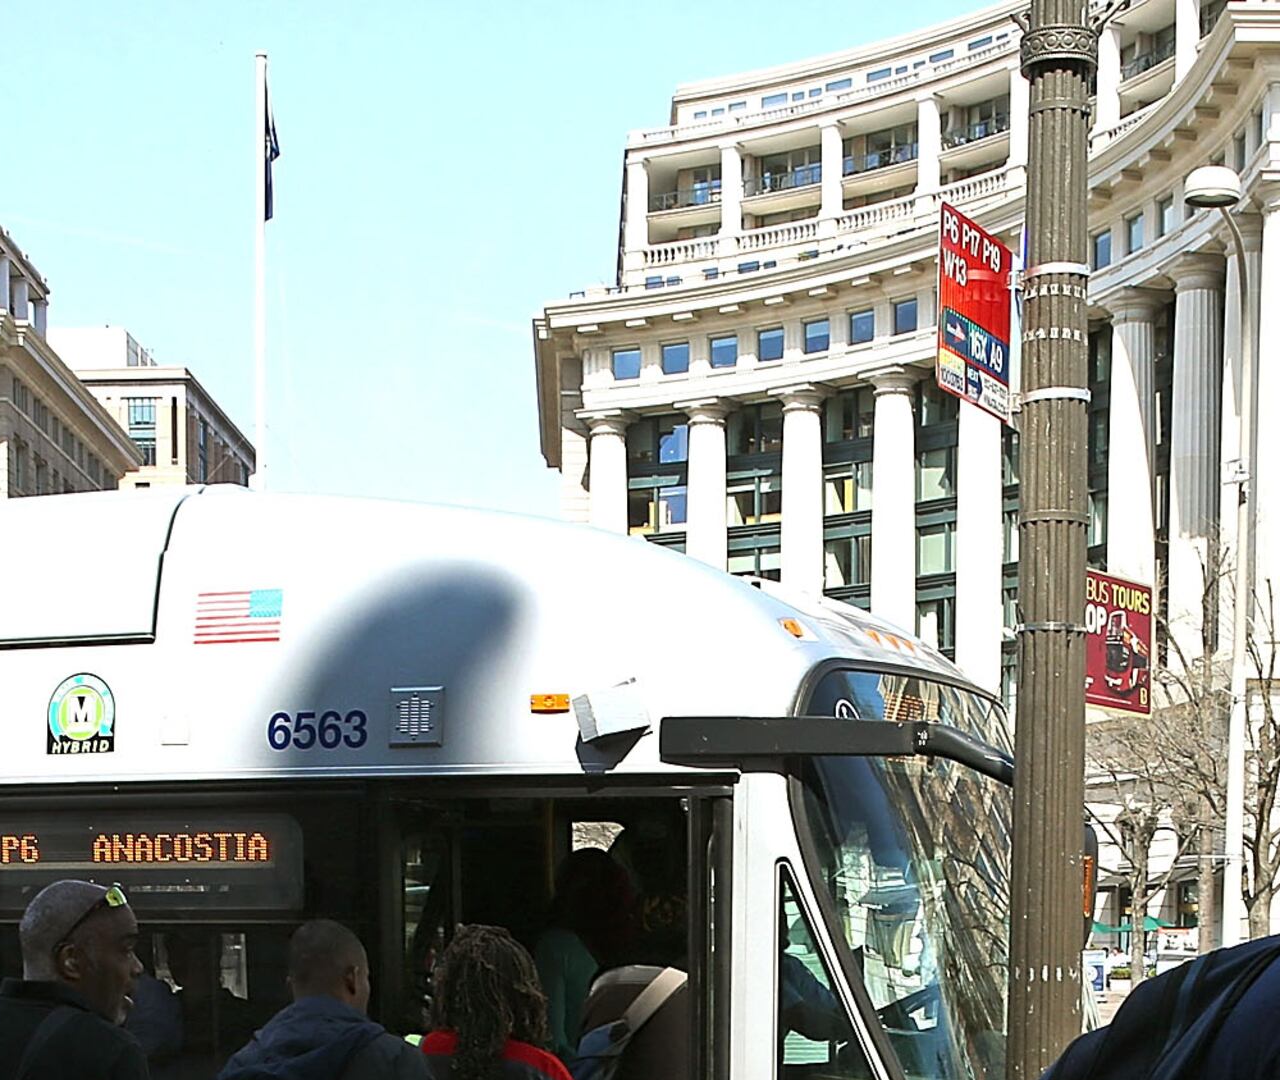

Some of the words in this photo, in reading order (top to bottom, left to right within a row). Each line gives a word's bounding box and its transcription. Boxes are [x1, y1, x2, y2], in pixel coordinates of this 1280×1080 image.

[943, 210, 959, 244] P6
[962, 223, 980, 257] P17
[983, 238, 1000, 273] P19
[943, 248, 967, 287] W13
[969, 329, 987, 364] 16X
[989, 342, 1003, 373] A9
[1086, 577, 1109, 604] BUS
[1111, 584, 1150, 615] TOURS
[52, 739, 109, 754] HYBRID
[268, 709, 368, 751] 6563
[1, 836, 39, 863] P6
[93, 832, 269, 863] ANACOSTIA
